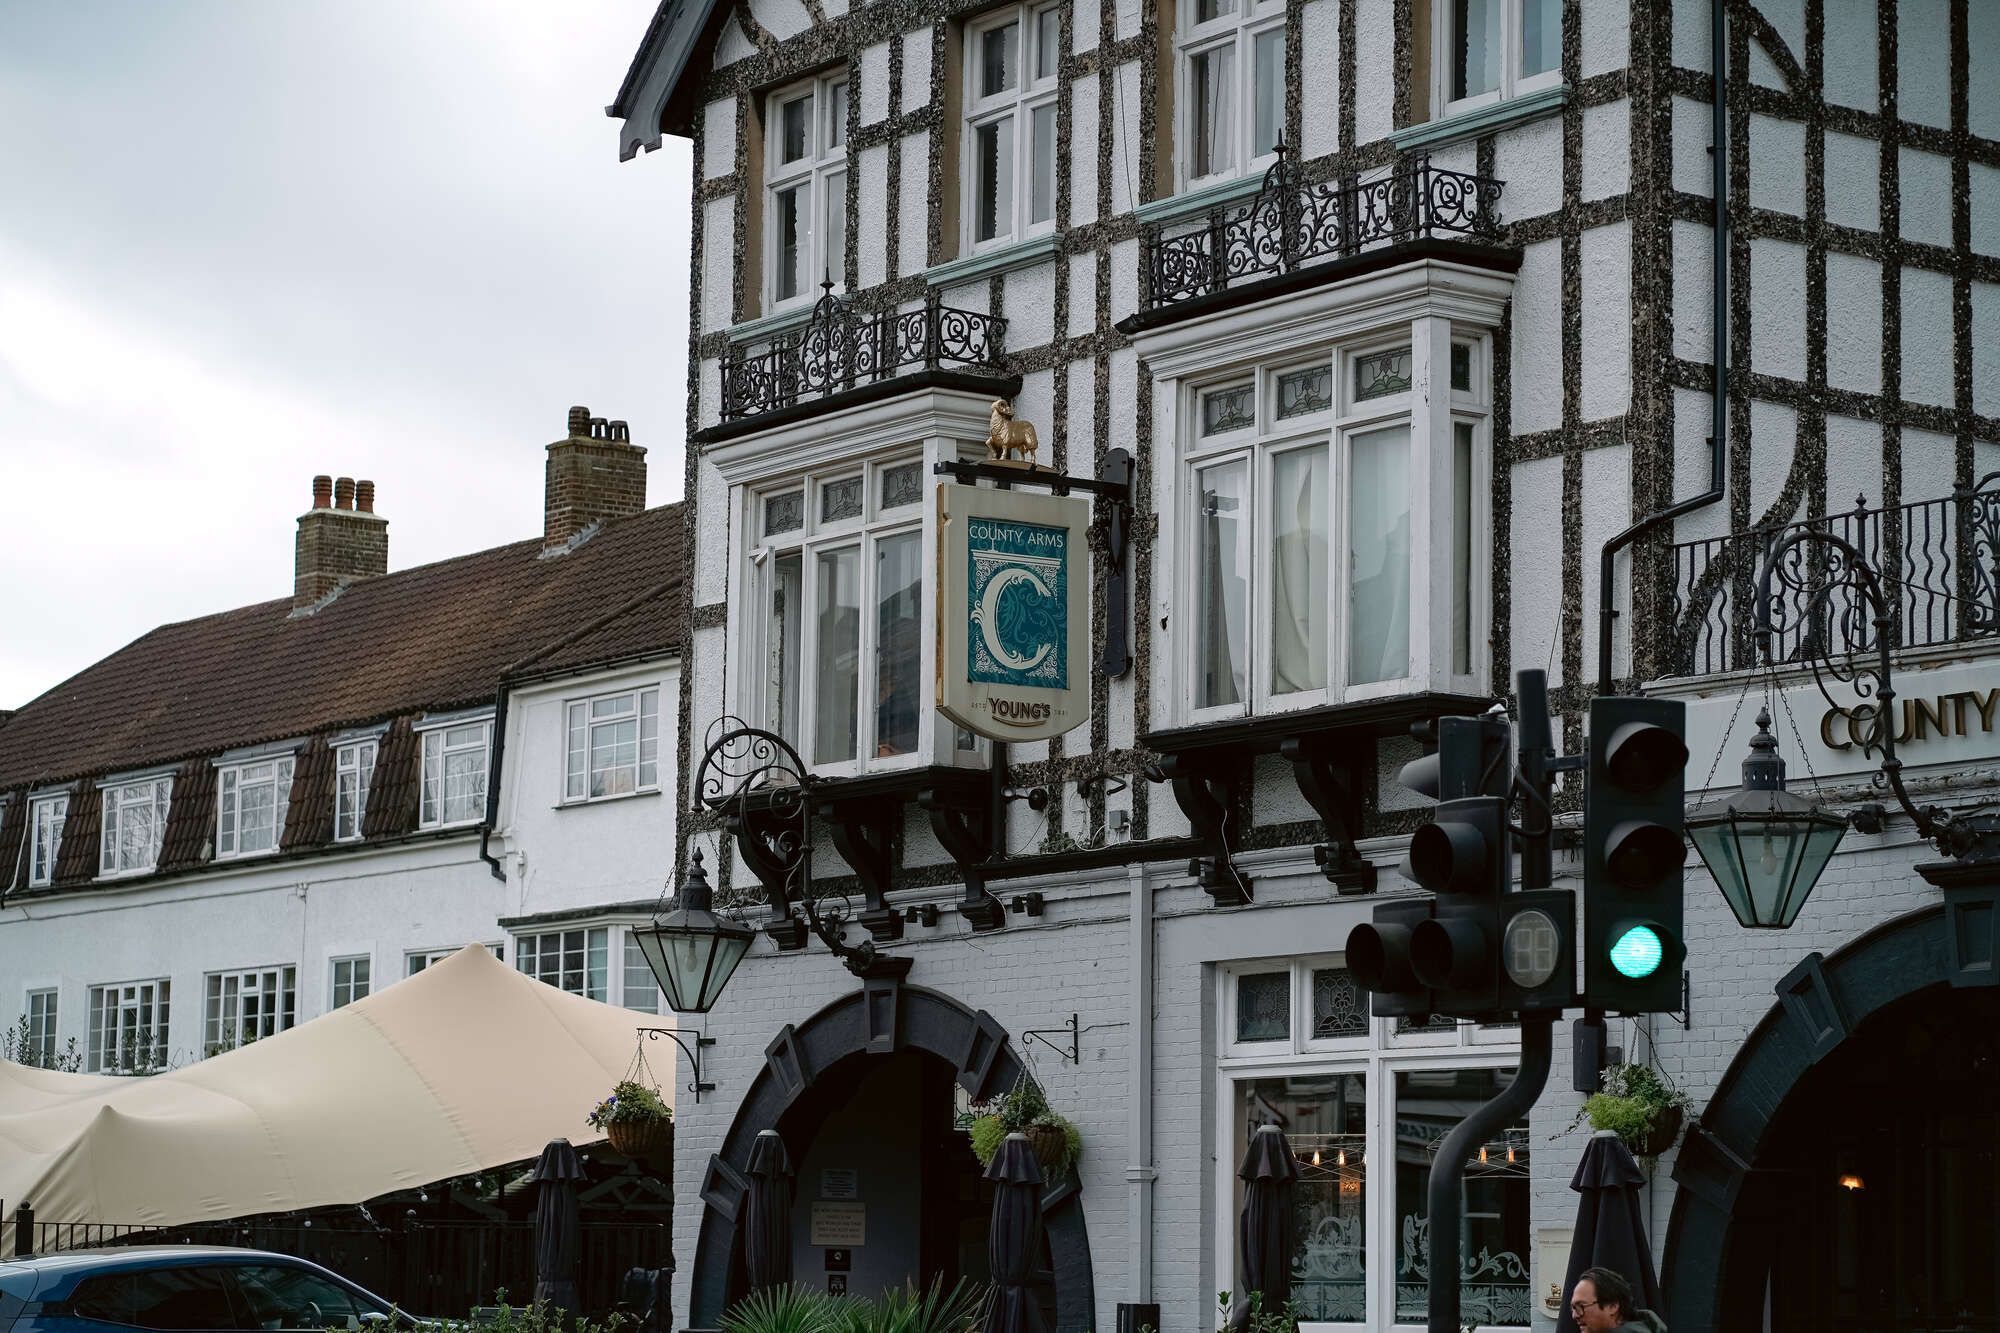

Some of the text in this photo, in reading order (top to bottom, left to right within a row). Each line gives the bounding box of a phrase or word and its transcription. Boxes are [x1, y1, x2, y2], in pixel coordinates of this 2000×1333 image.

[969, 522, 1064, 548] COUNTY ARMS
[988, 697, 1051, 719] YOUNG'S
[1820, 688, 2000, 751] COUNTY
